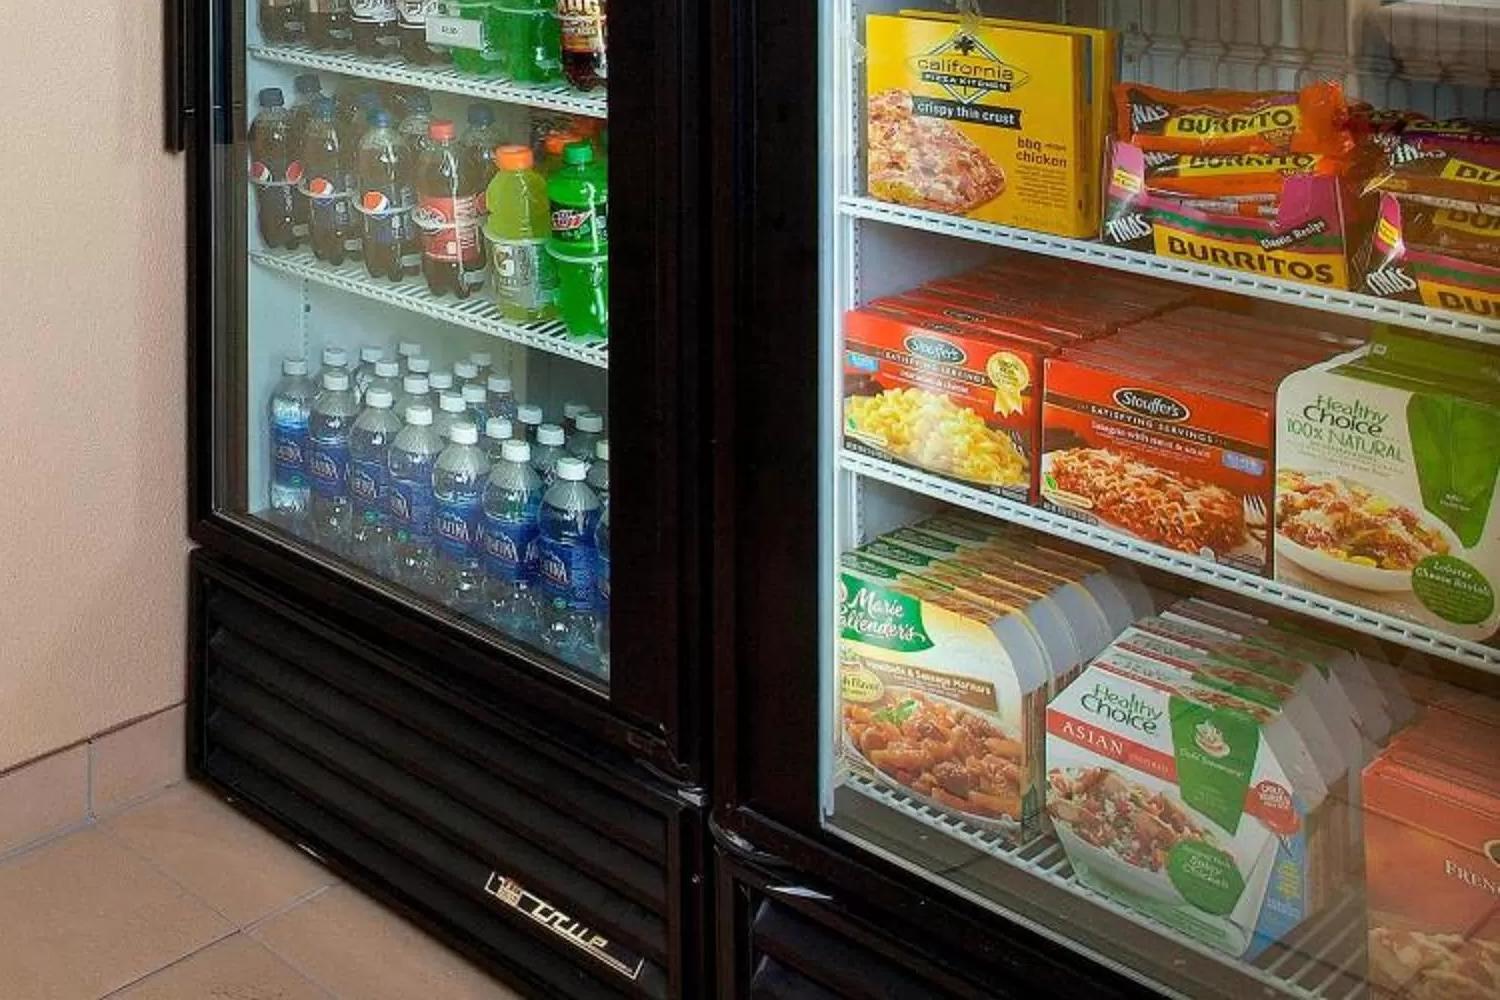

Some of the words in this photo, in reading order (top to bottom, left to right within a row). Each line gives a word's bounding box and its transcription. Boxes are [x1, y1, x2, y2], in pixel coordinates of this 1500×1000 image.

[916, 57, 1015, 82] california
[916, 101, 953, 118] crispy
[956, 105, 980, 119] thin
[982, 110, 1016, 126] crust
[1176, 108, 1295, 136] BURRITO
[1015, 149, 1068, 169] chicken
[1016, 135, 1043, 153] bbq
[1167, 236, 1335, 284] BURRITOS
[1122, 391, 1182, 418] Stouffer's
[1316, 394, 1389, 425] Healthy
[1090, 405, 1155, 429] SATISFYING
[1157, 421, 1214, 443] SERVINGS
[1303, 404, 1384, 438] Choice
[1285, 418, 1323, 440] 100%
[1328, 432, 1404, 461] NATURAL
[849, 587, 905, 618] Marie
[1080, 692, 1157, 735] Choice
[1093, 683, 1163, 720] Healthy
[1062, 721, 1125, 756] ASIAN
